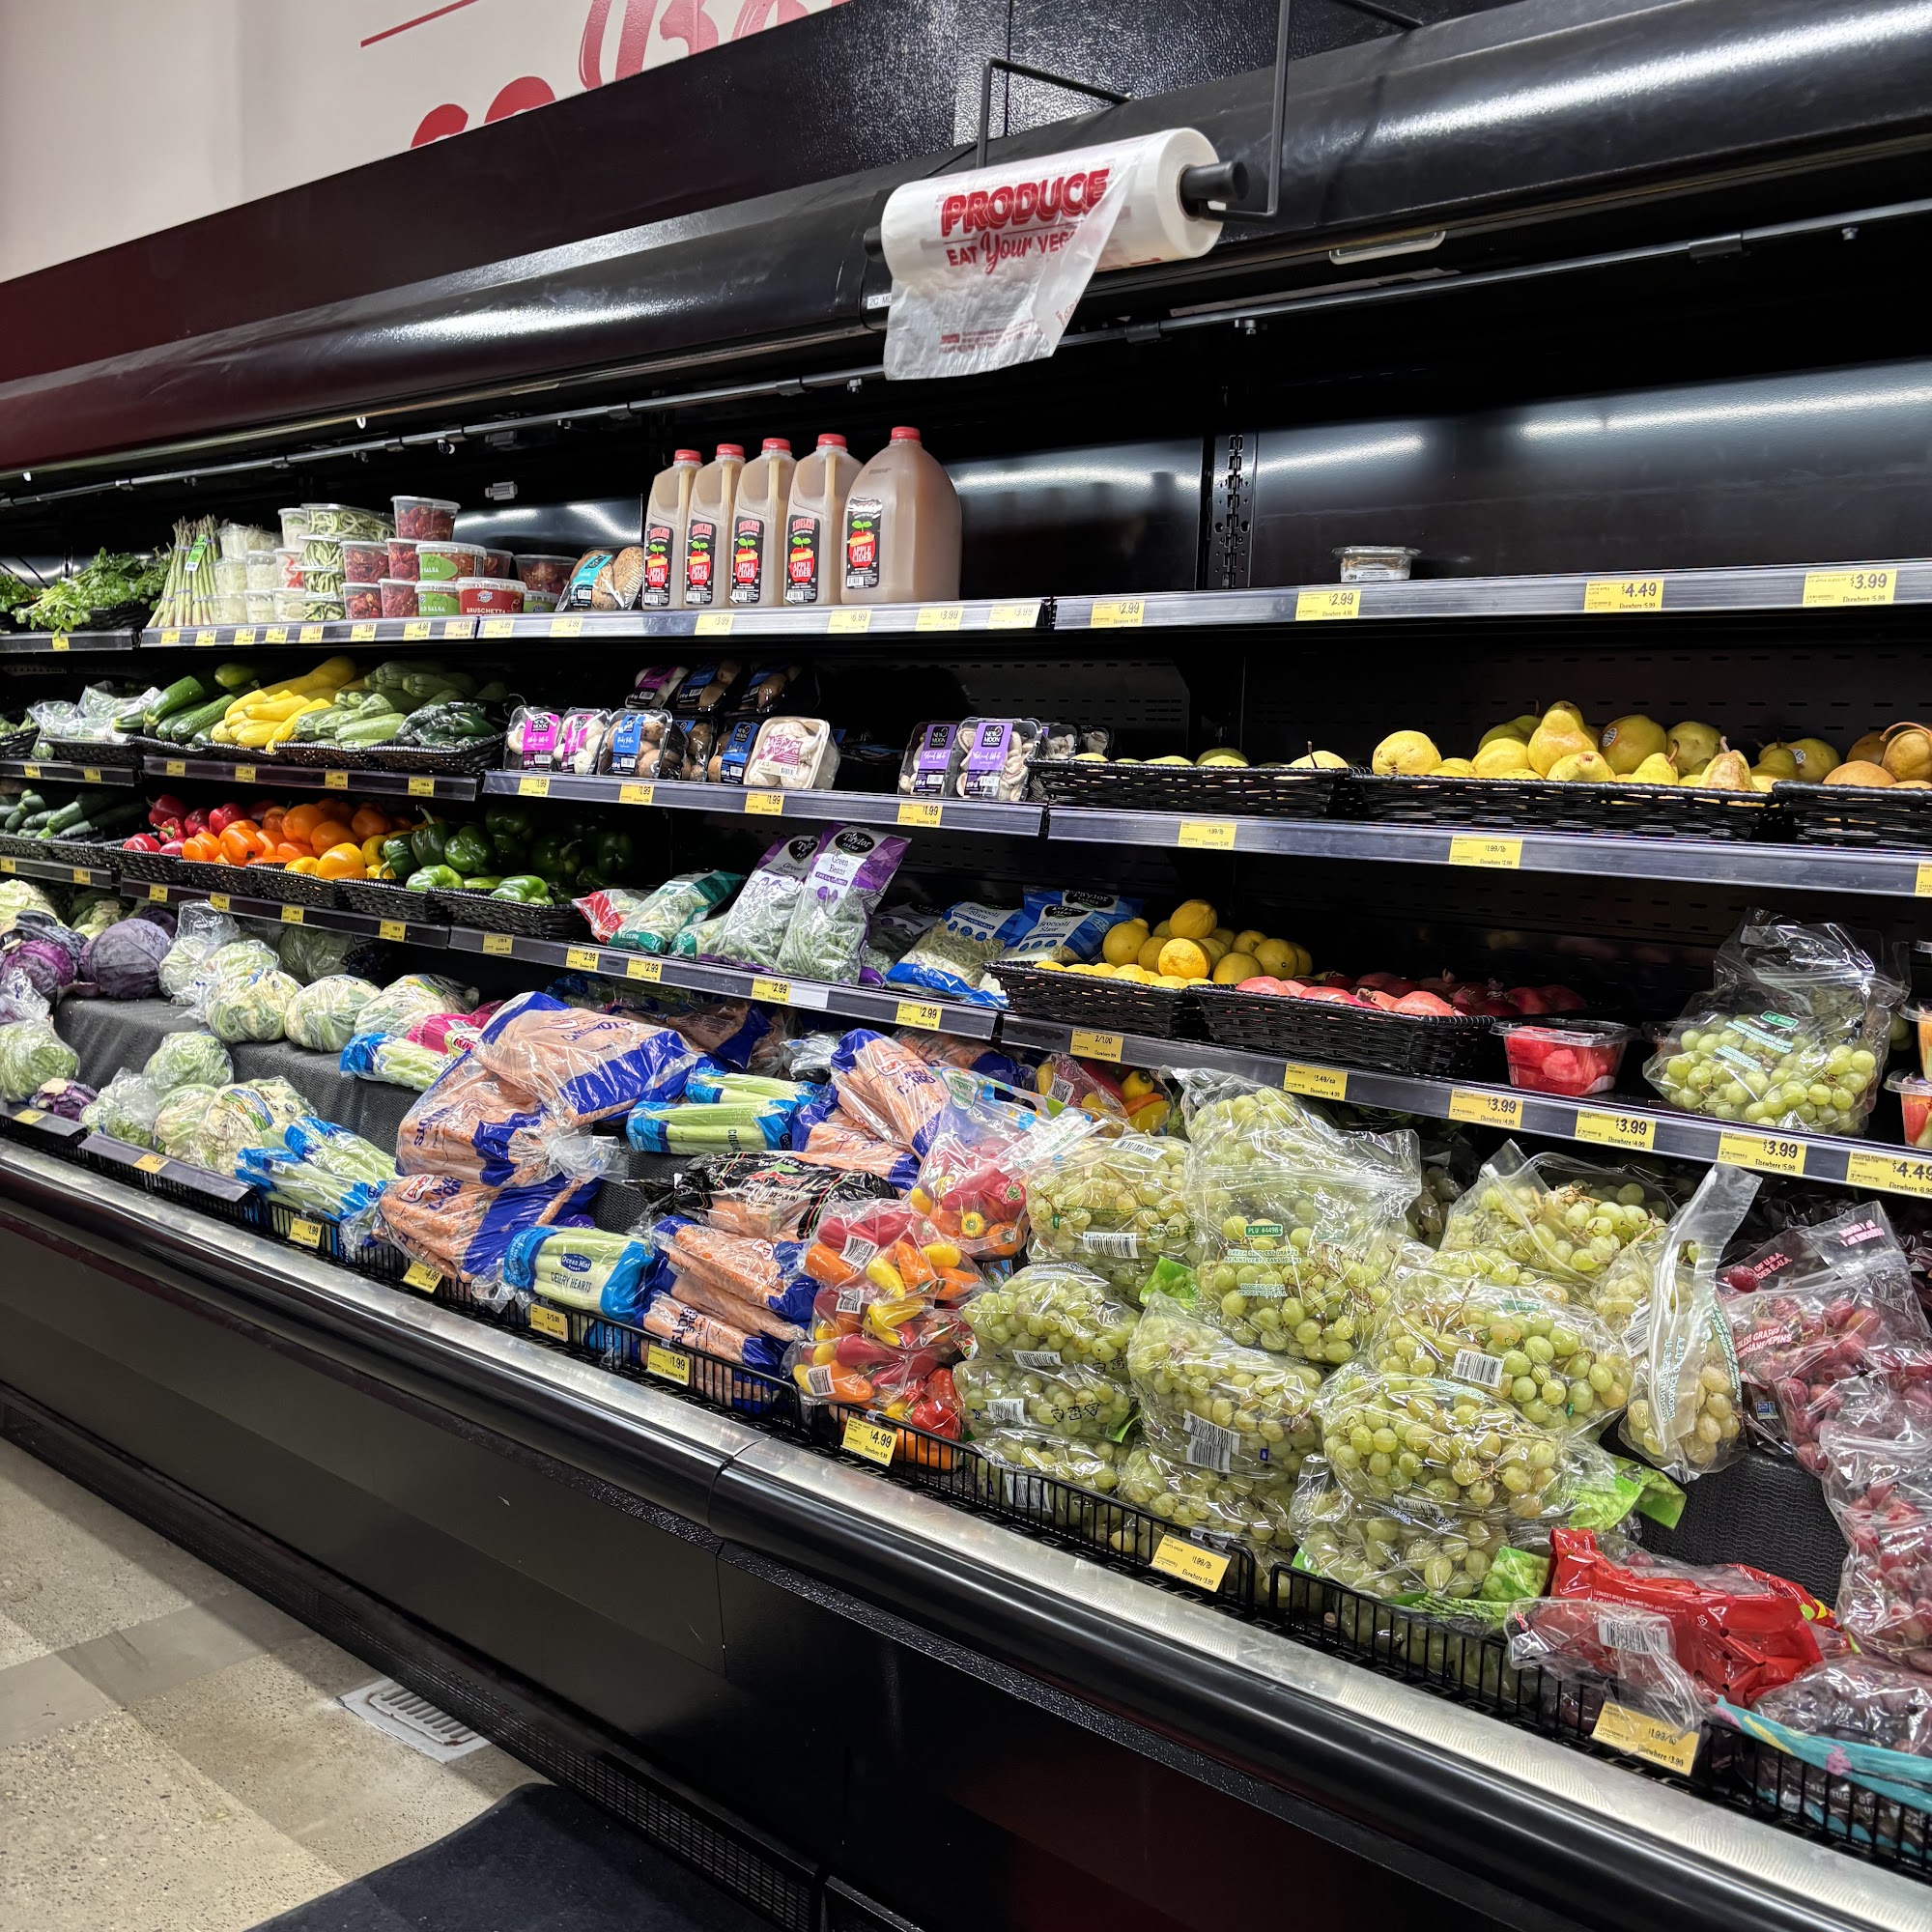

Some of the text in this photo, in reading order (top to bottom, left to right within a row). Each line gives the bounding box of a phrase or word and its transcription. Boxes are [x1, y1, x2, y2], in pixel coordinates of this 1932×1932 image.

[941, 167, 1111, 238] PRODUCE
[947, 245, 977, 268] EAT
[980, 232, 1033, 274] Your
[853, 545, 872, 554] APPLE
[852, 552, 873, 562] CIDER
[691, 565, 708, 574] APPLE
[738, 562, 754, 571] APPLE
[792, 562, 810, 571] APPLE
[648, 574, 666, 582] CIDER
[691, 572, 707, 581] CIDER
[737, 569, 755, 578] CIDER
[792, 569, 810, 578] CIDER
[1850, 573, 1888, 589] $3.99
[1621, 582, 1657, 598] $4.49
[843, 831, 871, 847] Taylor
[832, 855, 849, 867] Green
[1488, 1097, 1517, 1114] $3.99
[1615, 1118, 1647, 1135] $3.99
[1607, 1136, 1632, 1146] Elsewhere
[1763, 1139, 1798, 1159] $3.99
[1755, 1158, 1781, 1170] Elsewhere
[1889, 1181, 1918, 1193] Elsewhere
[562, 1256, 591, 1269] Ocean Mist
[1754, 1263, 1765, 1272] OF
[1757, 1267, 1773, 1279] DES
[551, 1271, 592, 1293] CELERY HEARTS
[1716, 1312, 1730, 1333] SANS
[1711, 1319, 1731, 1358] SEEDLESS
[669, 1355, 686, 1371] $1.99
[870, 1428, 893, 1448] $4.99
[1859, 1795, 1873, 1804] OF
